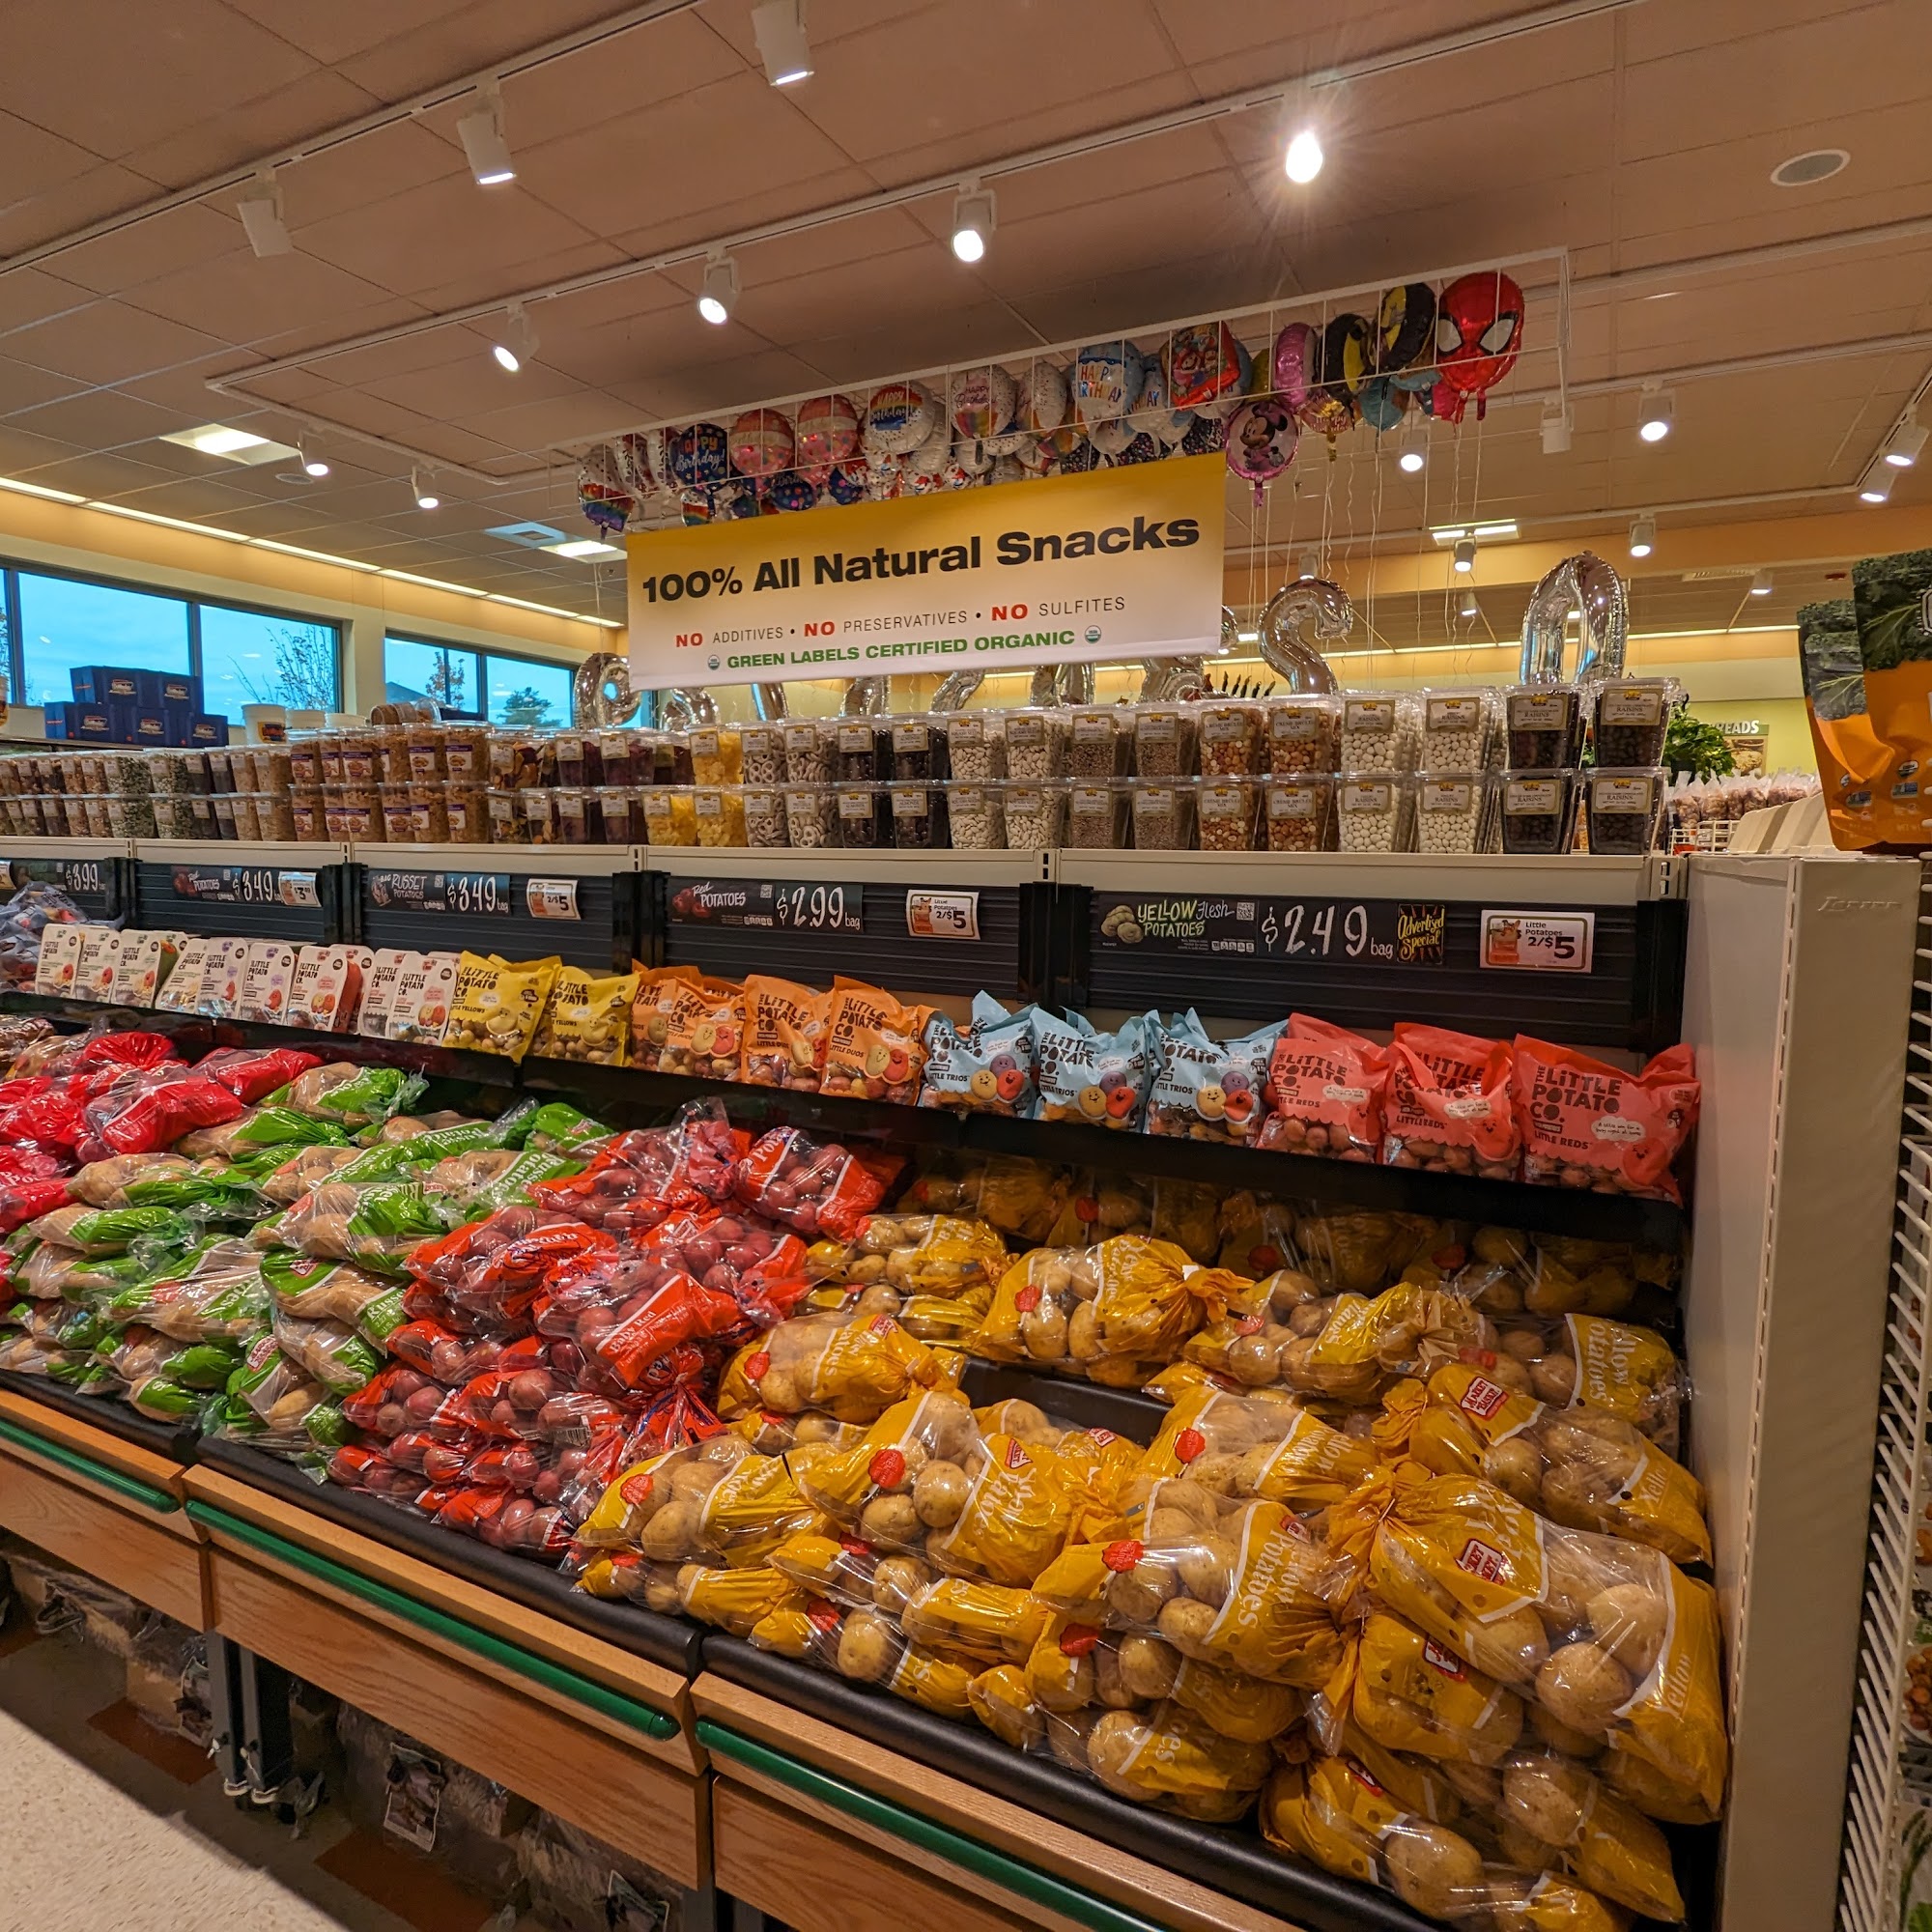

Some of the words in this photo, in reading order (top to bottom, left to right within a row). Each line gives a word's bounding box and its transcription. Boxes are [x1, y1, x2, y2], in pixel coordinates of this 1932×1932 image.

[643, 566, 743, 602] 100%
[753, 557, 800, 592] All
[814, 536, 980, 584] Natural
[996, 516, 1200, 565] Snacks
[676, 633, 703, 647] NO
[712, 627, 783, 643] ADDITIVES
[804, 621, 835, 637] NO
[843, 611, 967, 633] PRESERVATIVES
[991, 604, 1029, 621] NO
[1038, 596, 1125, 616] SULFITES
[727, 652, 785, 668] GREEN
[790, 646, 860, 664] LABELS
[866, 639, 967, 658] CERTIFIED
[974, 631, 1075, 651] ORGANIC
[1719, 720, 1760, 734] READS
[193, 878, 220, 892] POTATOES
[391, 873, 428, 890] RUSSET
[692, 881, 715, 897] Red
[393, 889, 424, 899] POTATOES
[446, 875, 497, 912] $3.49
[497, 899, 510, 914] bag
[547, 895, 570, 912] 2/$5
[700, 892, 747, 908] POTATOES
[776, 886, 845, 928] $2.99
[844, 914, 862, 930] bag
[1137, 899, 1199, 923] YELLOW
[1196, 899, 1236, 920] Flesh
[936, 910, 967, 929] 2/$5
[1144, 919, 1206, 938] POTATOES
[1397, 908, 1445, 941] Advertised
[1525, 921, 1547, 929] Little
[1261, 904, 1368, 956] $2.49
[1370, 937, 1394, 959] bag
[1525, 928, 1564, 937] Potatoes
[1401, 928, 1441, 961] Special
[1527, 936, 1577, 959] 2/$5
[405, 973, 427, 981] LITTLE
[458, 977, 497, 990] POTATO
[466, 967, 499, 980] LITTLE
[399, 980, 424, 989] POTATO
[763, 994, 809, 1021] LITTLE
[848, 997, 888, 1022] LITTLE
[835, 1023, 856, 1039] CO.
[838, 1009, 883, 1032] POTATO
[1040, 1031, 1051, 1044] THE
[830, 1044, 846, 1054] LITTLE
[846, 1048, 866, 1060] DUOS
[1271, 1065, 1346, 1086] POTATO
[1286, 1054, 1349, 1077] LITTLE
[1423, 1053, 1487, 1082] LITTLE
[1535, 1065, 1546, 1083] THE
[946, 1073, 968, 1082] TRIOS
[1270, 1074, 1302, 1090] CO.
[1546, 1068, 1624, 1096] LITTLE
[1054, 1087, 1075, 1097] TRIOS
[1170, 1083, 1193, 1094] TRIOS
[1531, 1083, 1621, 1114] POTATO
[1295, 1098, 1321, 1108] REDS
[1529, 1101, 1566, 1123] CO.
[105, 1117, 133, 1137] Red
[1534, 1129, 1557, 1145] LITTLE
[1559, 1136, 1589, 1150] REDS
[365, 1288, 405, 1321] Russe
[609, 1326, 637, 1353] Baby
[635, 1311, 658, 1327] Red
[1588, 1322, 1608, 1401] otatoes
[1611, 1328, 1638, 1387] ellow
[1463, 1379, 1489, 1409] MARKET
[1476, 1387, 1501, 1410] BASKET
[1237, 1540, 1284, 1630] Potatoes
[1658, 1652, 1691, 1719] Yellow
